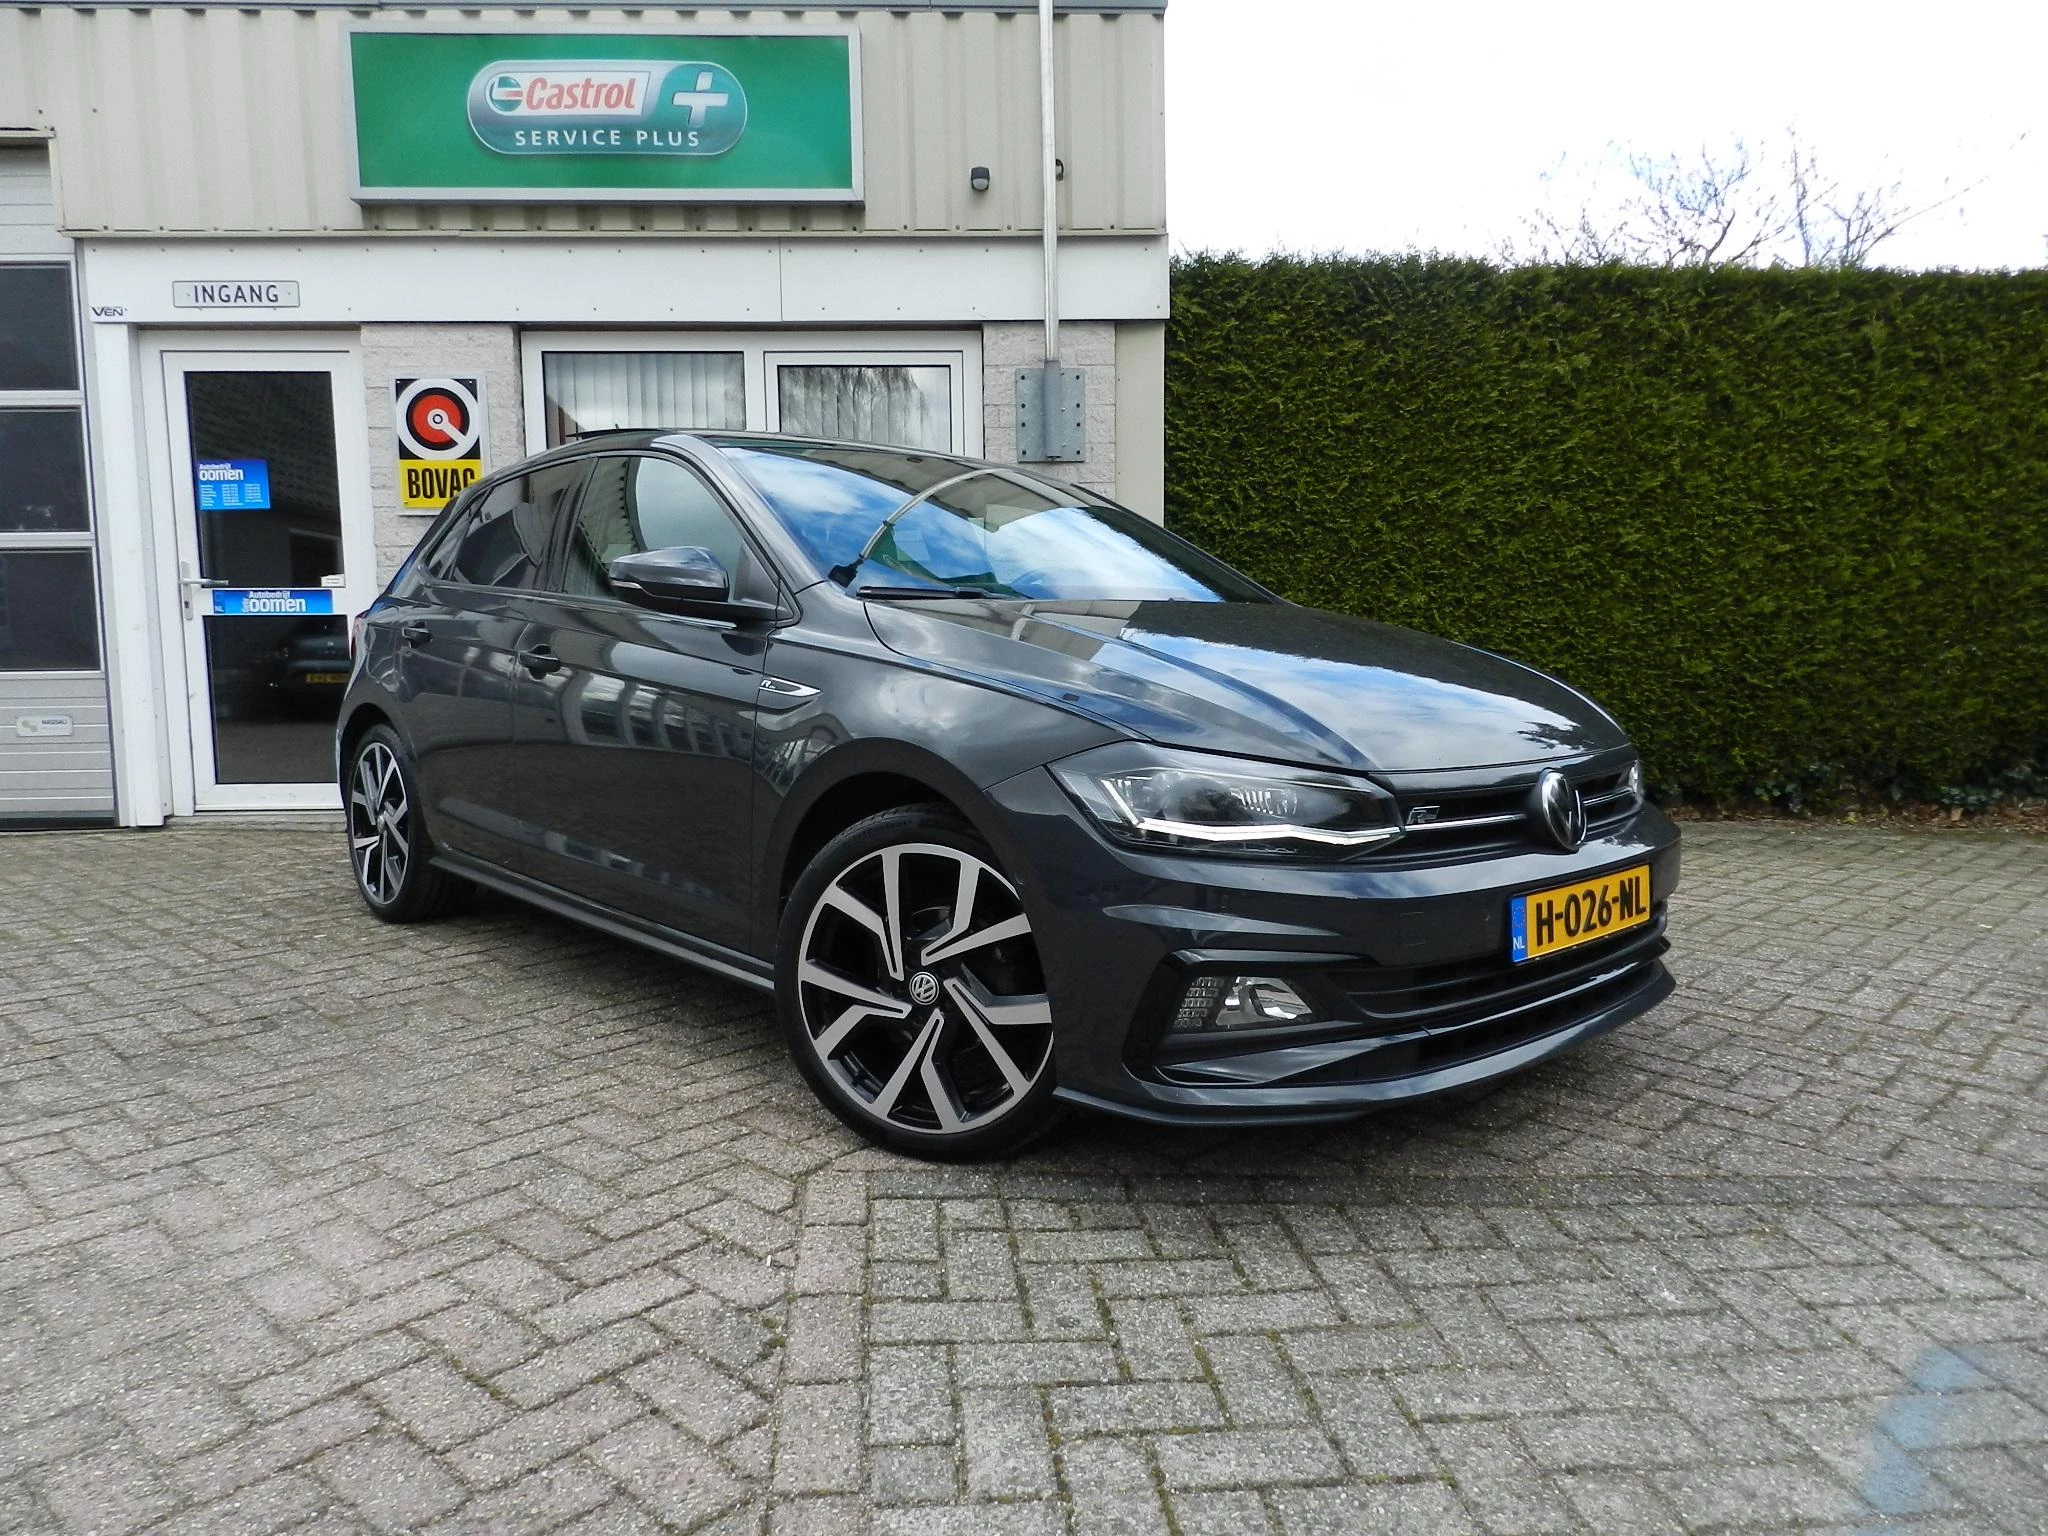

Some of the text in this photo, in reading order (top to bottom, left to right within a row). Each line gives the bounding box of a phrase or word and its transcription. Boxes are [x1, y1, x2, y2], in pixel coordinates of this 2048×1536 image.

[526, 77, 636, 110] Castrol
[515, 130, 699, 146] SERVICE PLUS
[194, 284, 279, 303] INGANG
[1512, 876, 1647, 951] NL H-026-NL
